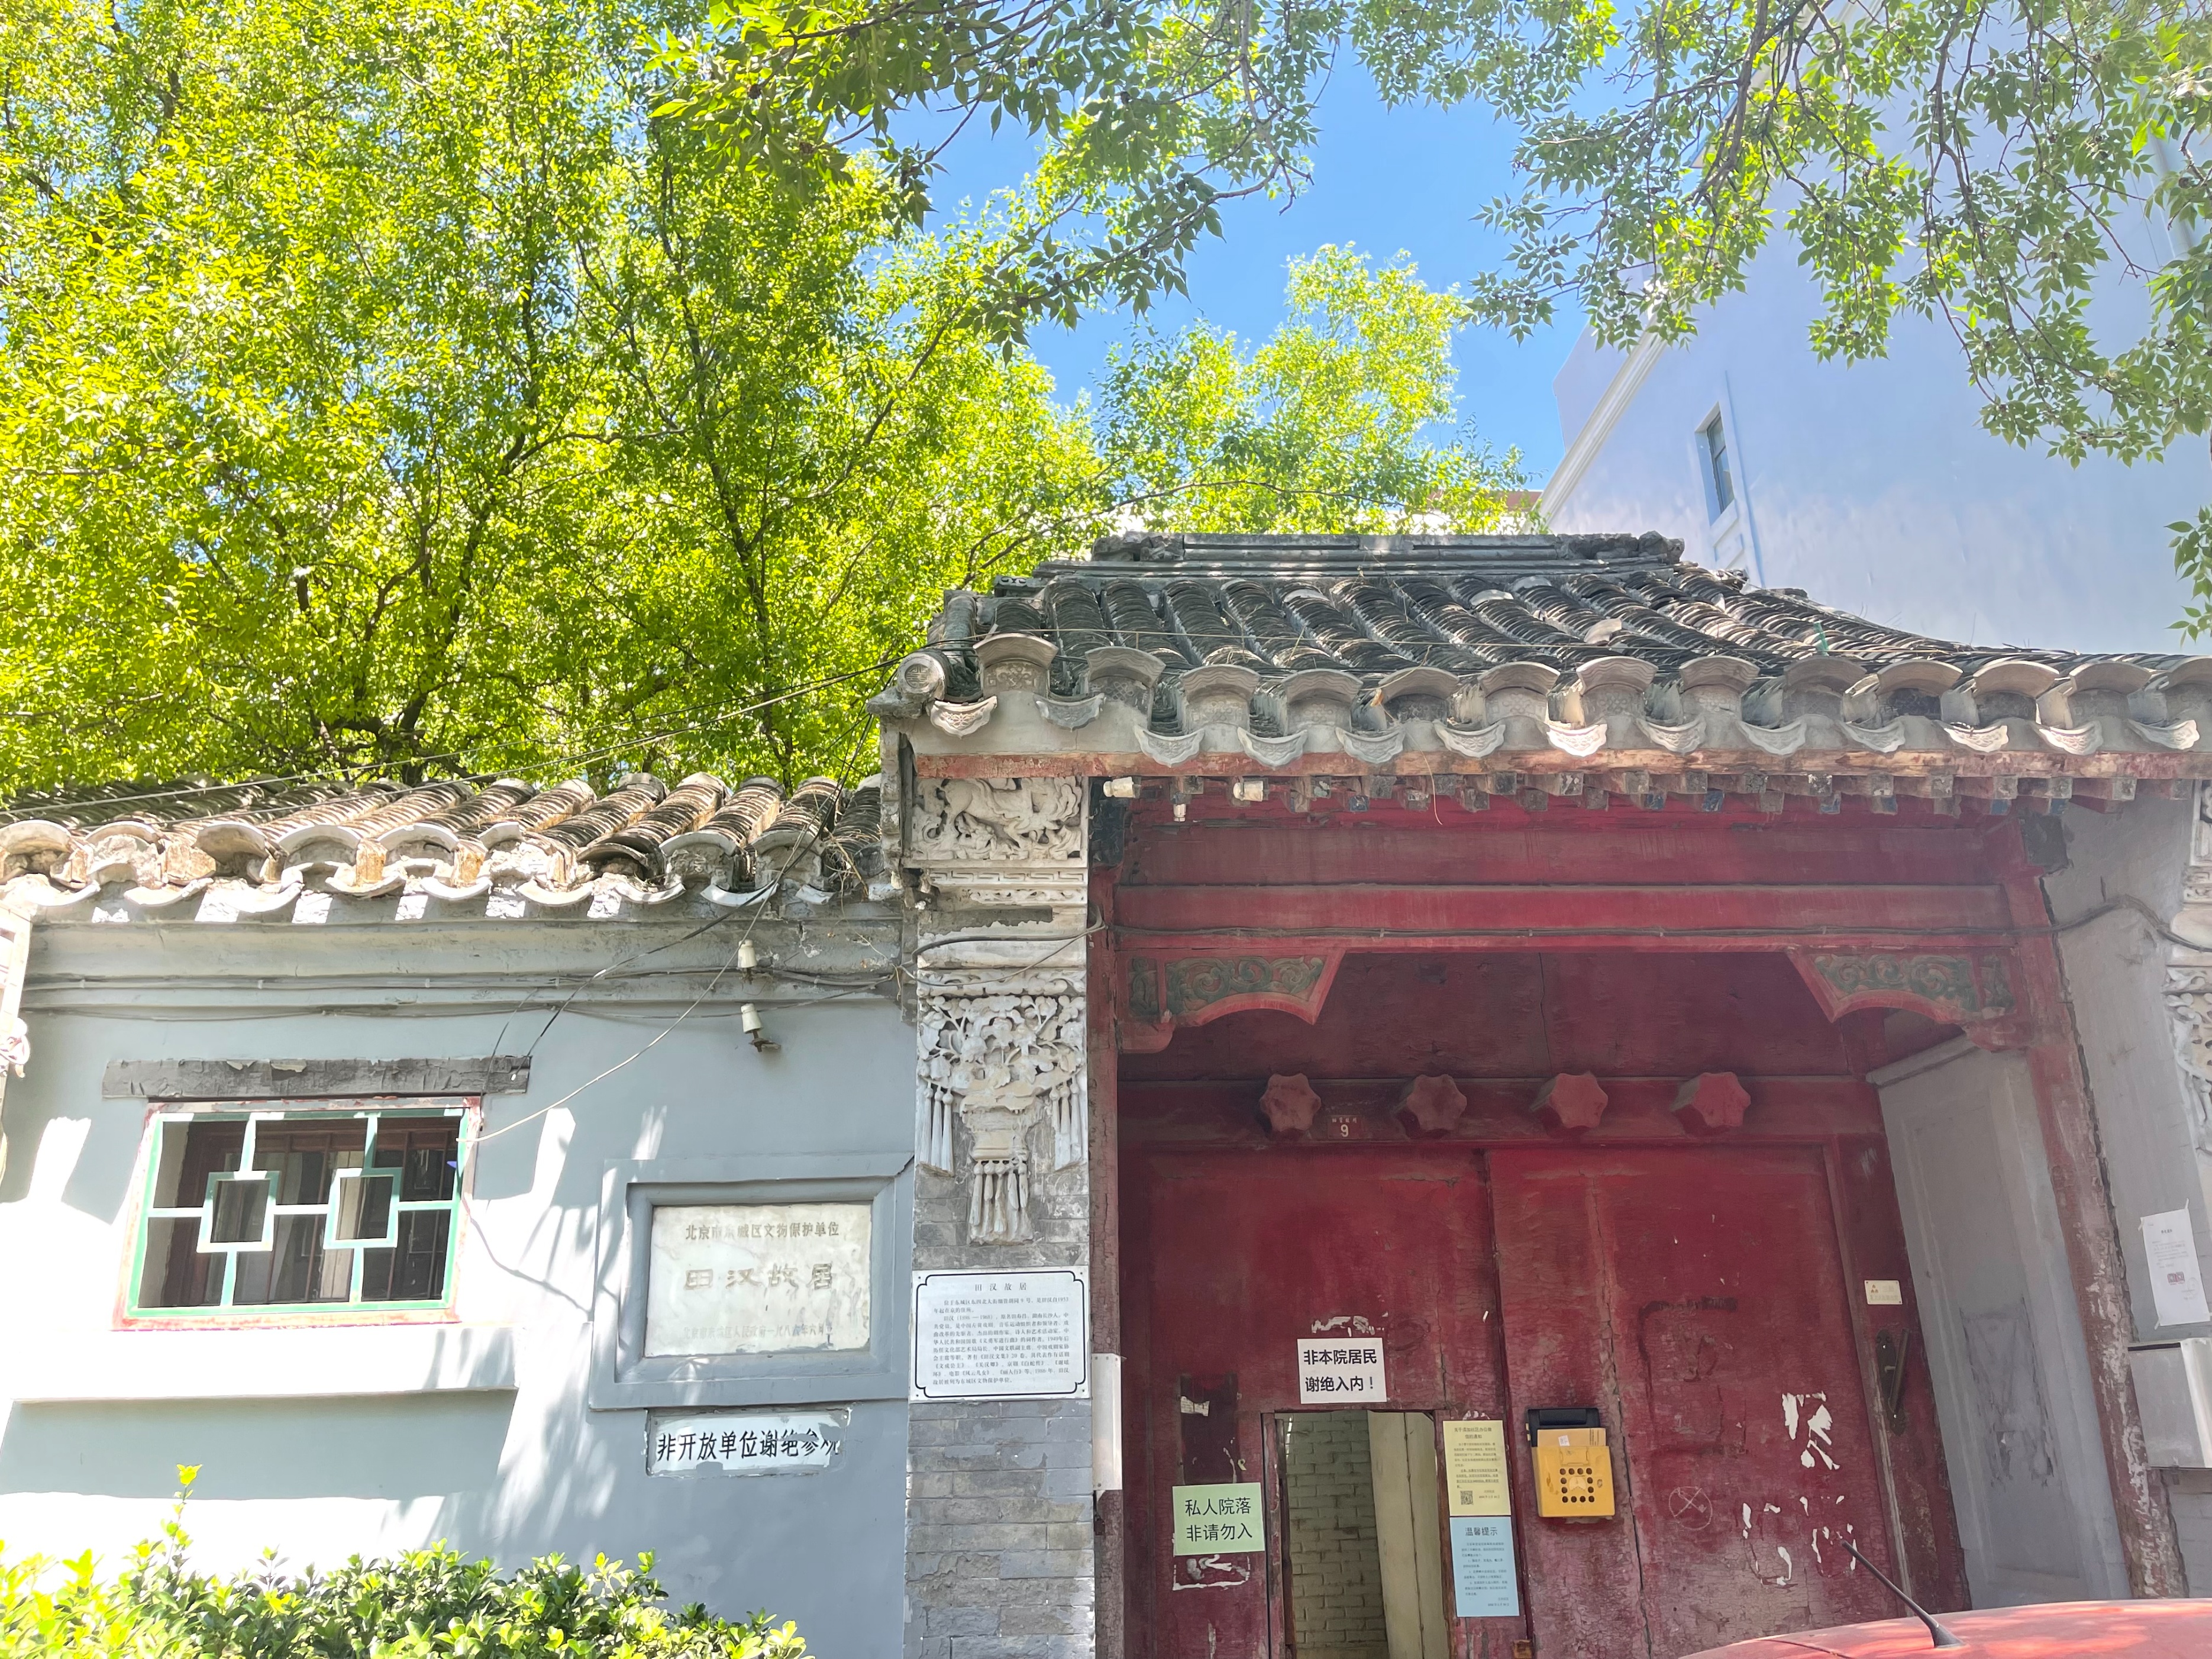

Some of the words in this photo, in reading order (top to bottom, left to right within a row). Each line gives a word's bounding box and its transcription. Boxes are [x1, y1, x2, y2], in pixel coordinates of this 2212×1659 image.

[1341, 1124, 1349, 1137] 9
[685, 1221, 839, 1241] 北京市东城区文物保护单位
[683, 1263, 834, 1291] 田汉故居
[975, 1282, 1027, 1292] 田汉故居
[1303, 1349, 1377, 1365] 非本院居民
[1184, 1497, 1251, 1517] 私人院落
[1186, 1522, 1252, 1542] 非请勿入
[1465, 1526, 1498, 1537] 温馨提示
